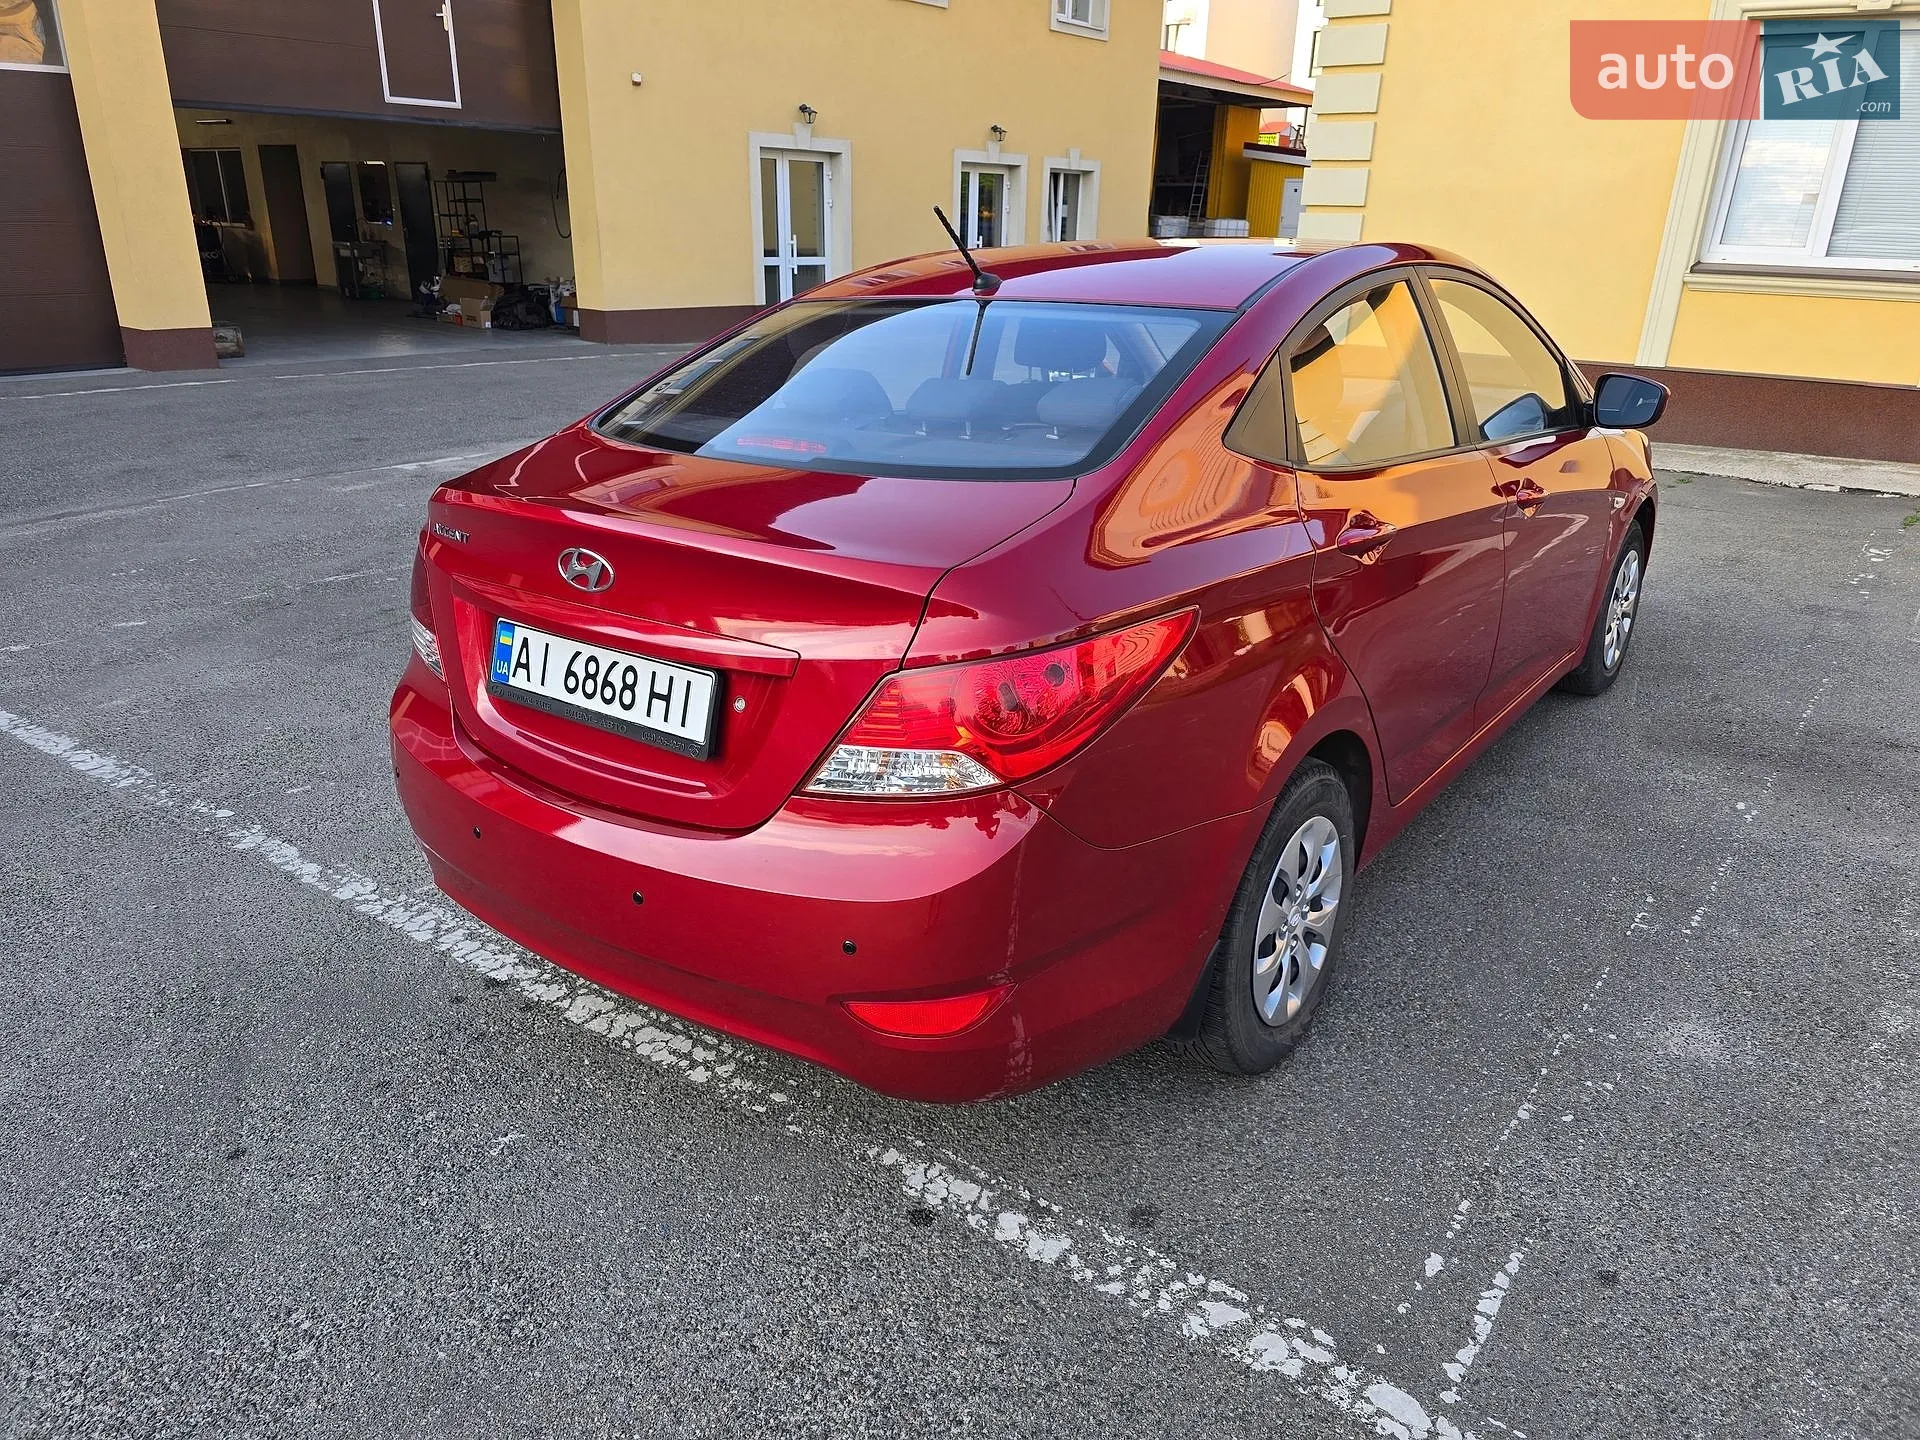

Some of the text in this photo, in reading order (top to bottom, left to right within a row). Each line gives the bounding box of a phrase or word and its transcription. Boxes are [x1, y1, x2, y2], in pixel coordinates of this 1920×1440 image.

[433, 522, 470, 545] ACCENT
[496, 659, 509, 676] UA
[511, 637, 692, 728] AI 6868 HI
